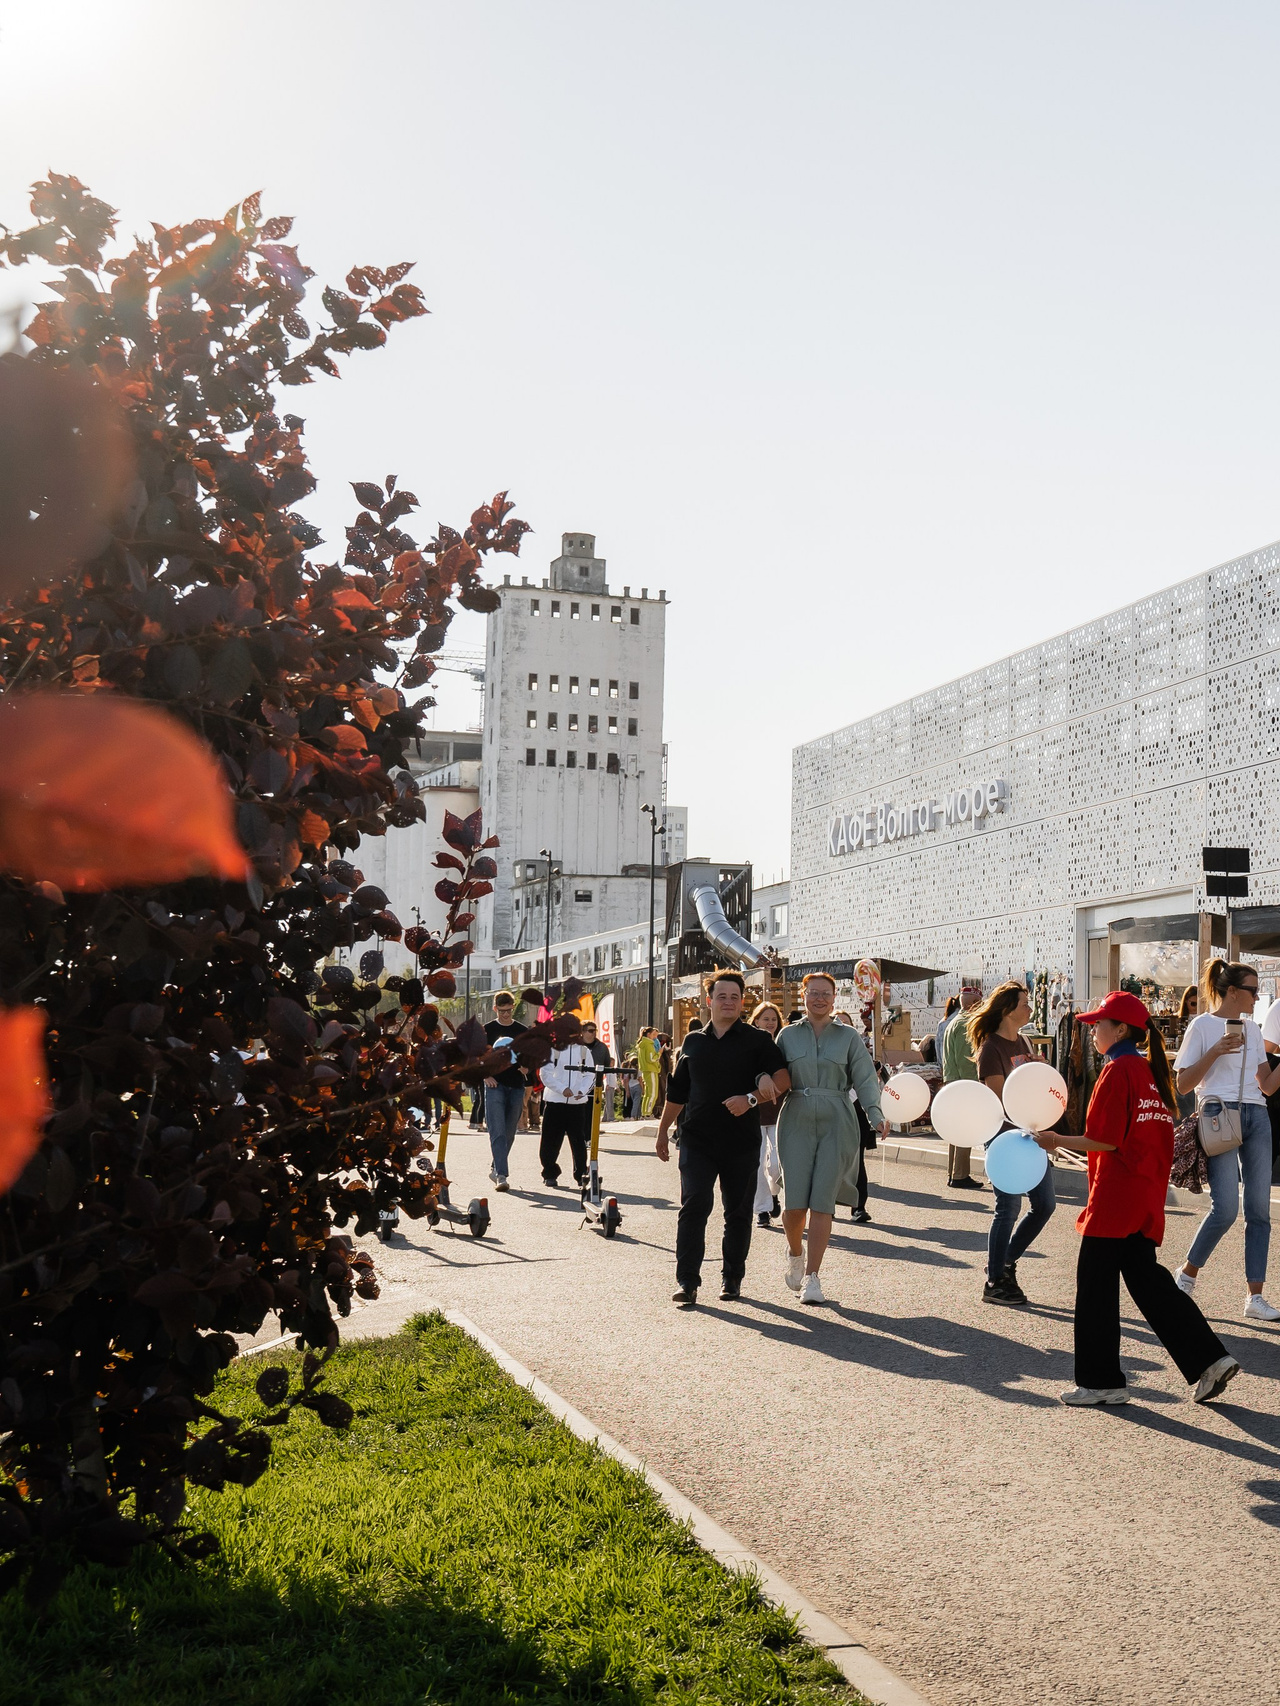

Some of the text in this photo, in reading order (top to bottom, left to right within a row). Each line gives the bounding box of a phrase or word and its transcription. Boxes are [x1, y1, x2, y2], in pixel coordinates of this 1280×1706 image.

[827, 806, 877, 857] КАФЕ
[884, 1085, 900, 1101] алва
[1153, 1112, 1174, 1125] все
